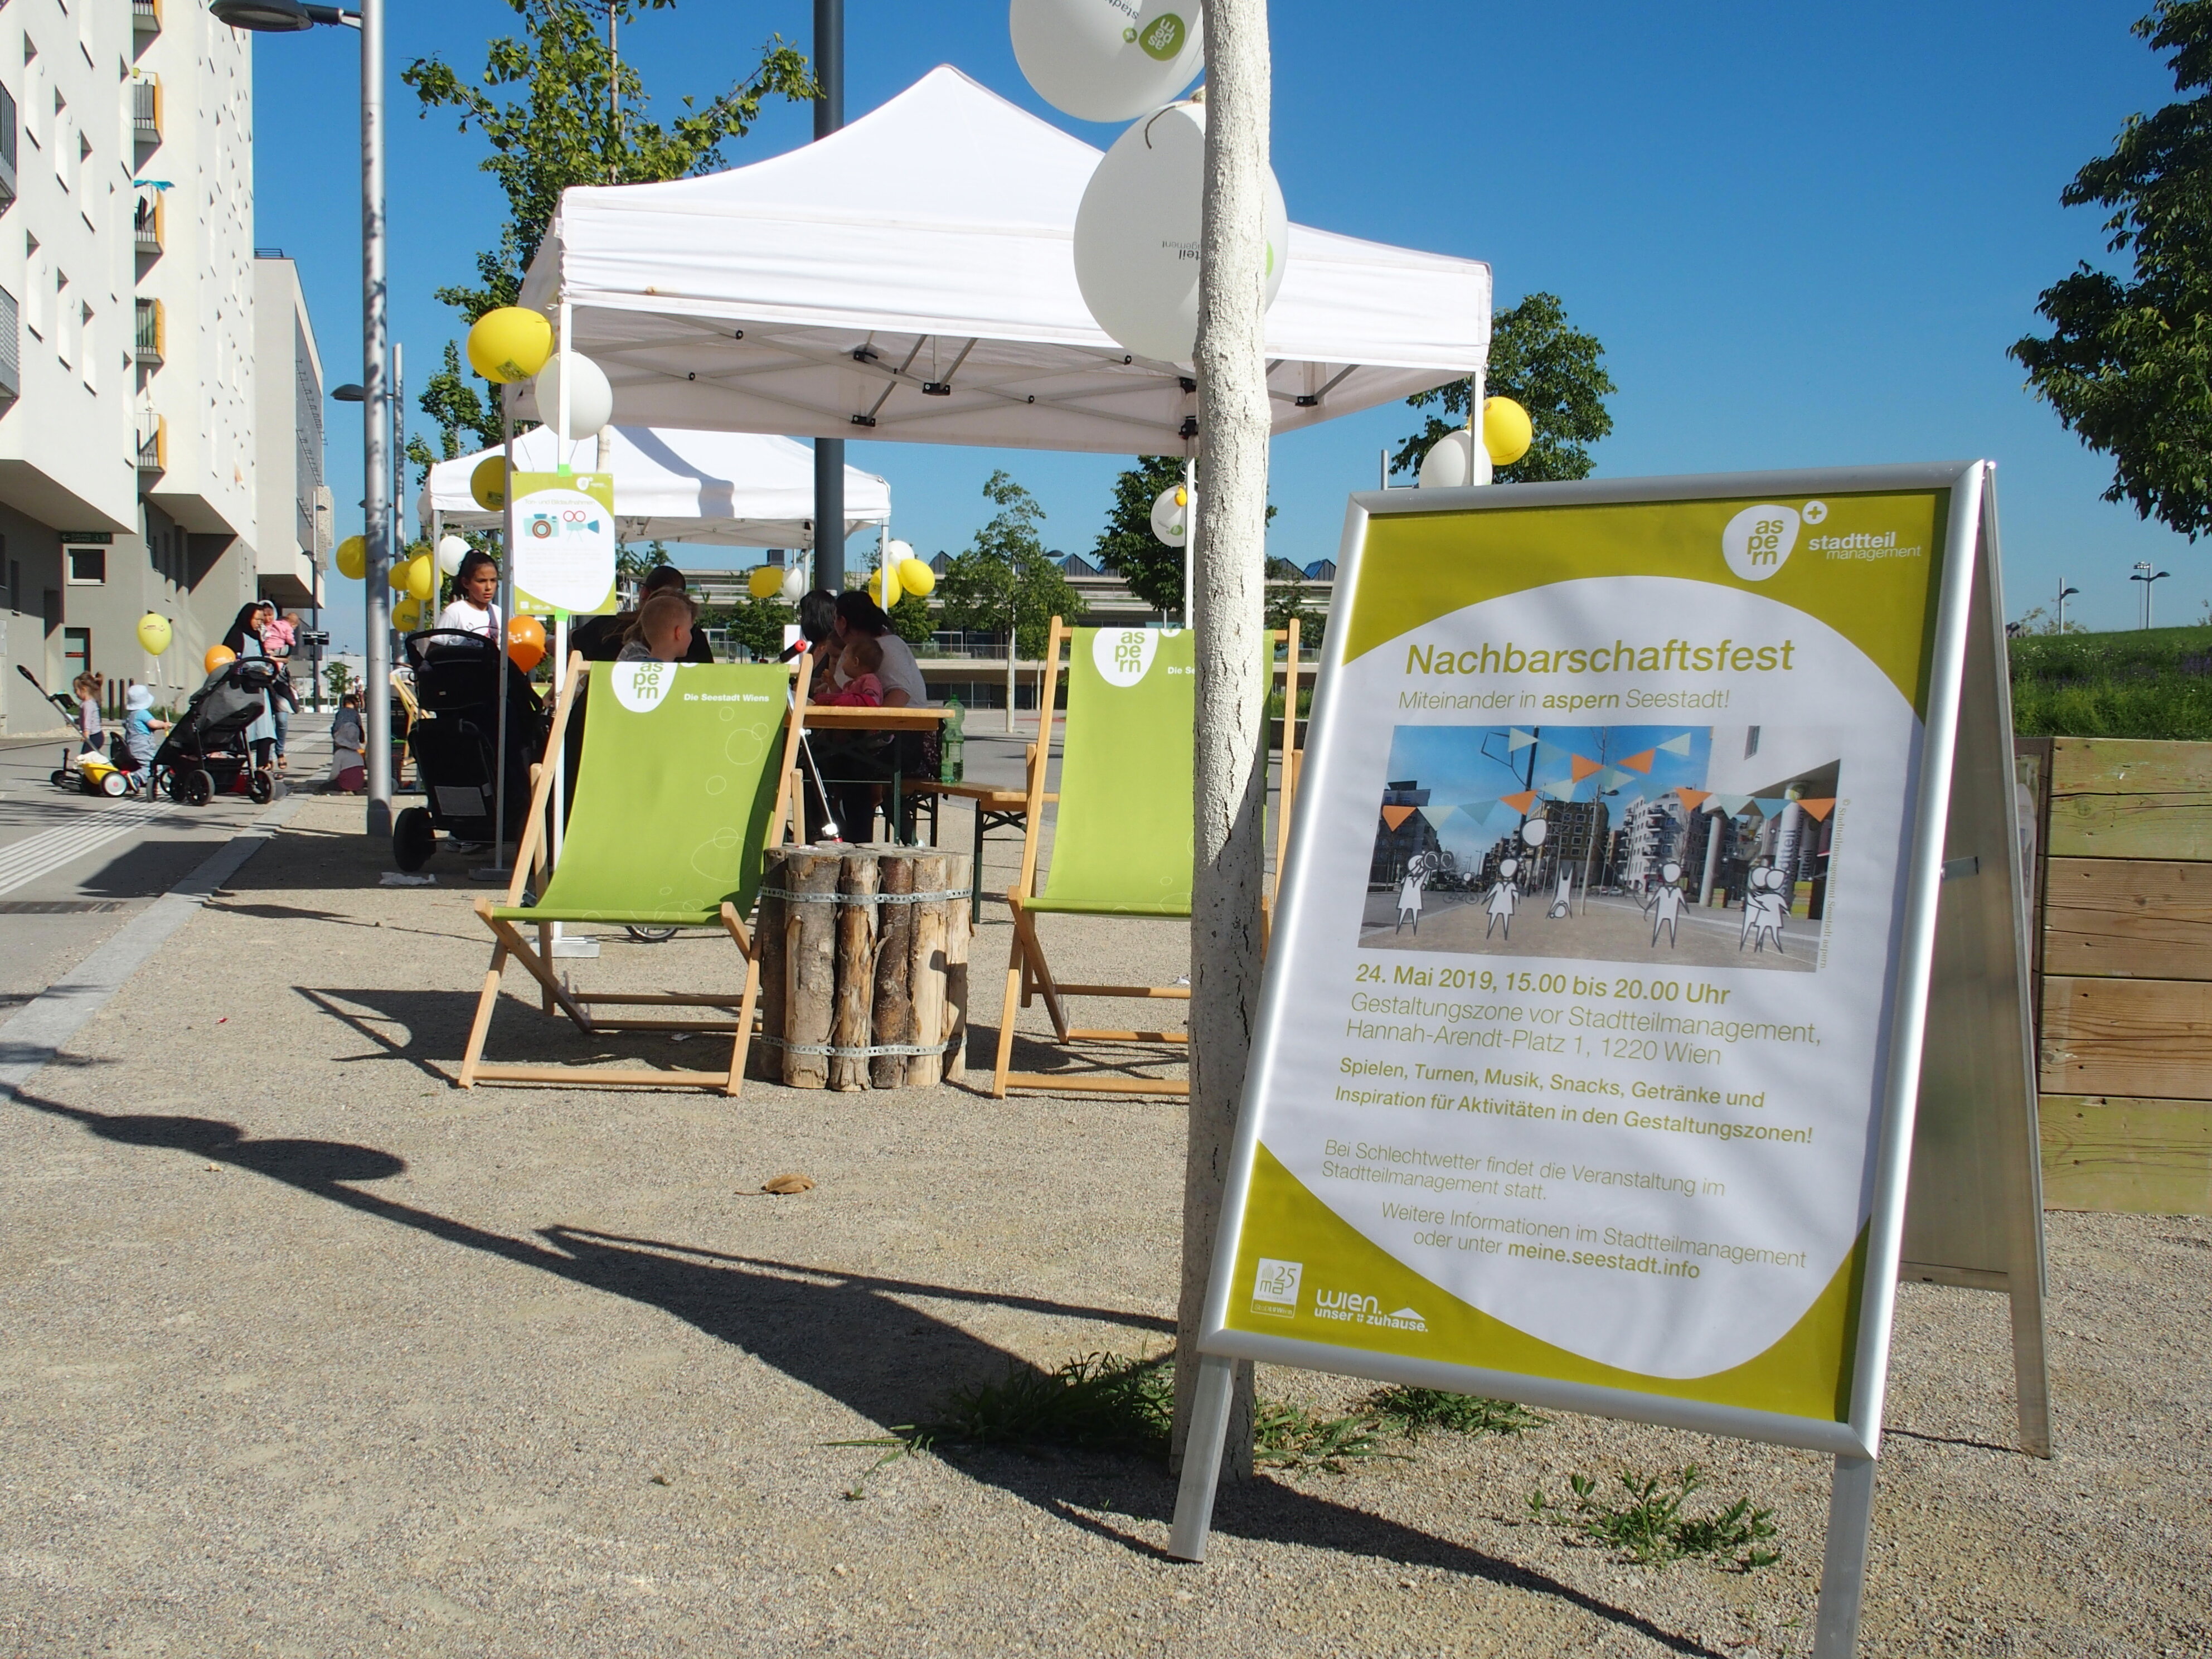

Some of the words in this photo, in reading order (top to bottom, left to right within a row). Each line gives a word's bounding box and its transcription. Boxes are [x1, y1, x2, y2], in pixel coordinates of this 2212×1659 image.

[1808, 531, 1896, 551] stadtteil
[1826, 546, 1922, 561] management
[1405, 638, 1795, 675] Nachbarschaftsfest
[1399, 690, 1515, 709] Miteinander
[1519, 690, 1536, 707] in
[1541, 694, 1619, 713] aspern
[1626, 688, 1729, 708] Seestadt!
[1828, 807, 1846, 899] Stadtteilmanagement
[1823, 901, 1835, 937] Seestadt
[1355, 963, 1386, 983] 24.
[1393, 965, 1433, 986] Mai
[1438, 968, 1497, 993] 2019,
[1506, 972, 1566, 994] 15.00
[1571, 975, 1607, 997] bis
[1613, 978, 1679, 1001] 20.00
[1686, 982, 1730, 1005] Uhr
[1351, 991, 1523, 1023] Gestaltungszone
[1529, 1007, 1564, 1023] vor
[1568, 1005, 1820, 1046] Stadtteilmanagement,
[1346, 1018, 1565, 1052] Hannah-Arendt-Platz
[1574, 1035, 1590, 1057] 1,
[1602, 1037, 1657, 1060] 1220
[1664, 1041, 1721, 1065] Wien
[1339, 1056, 1408, 1080] Spielen,
[1414, 1063, 1478, 1086] Turnen,
[1484, 1068, 1543, 1091] Musik,
[1549, 1073, 1624, 1098] Snacks,
[1631, 1080, 1721, 1104] Getränke
[1726, 1091, 1765, 1108] und
[1335, 1085, 1426, 1108] Inspiration
[1430, 1093, 1455, 1110] für
[1456, 1095, 1556, 1119] Aktivitäten
[1560, 1104, 1577, 1121] in
[1582, 1107, 1618, 1125] den
[1623, 1110, 1813, 1143] Gestaltungszonen!
[1322, 1160, 1498, 1195] Stadtteilmanagement
[1503, 1182, 1545, 1200] statt.
[1325, 1139, 1350, 1157] Bei
[1355, 1142, 1481, 1170] Schlechtwetter
[1487, 1156, 1534, 1176] findet
[1539, 1162, 1565, 1179] die
[1572, 1164, 1696, 1197] Veranstaltung
[1702, 1182, 1724, 1195] im
[1382, 1201, 1444, 1224] Weitere
[1450, 1209, 1569, 1239] Informationen
[1575, 1224, 1597, 1242] im
[1603, 1227, 1806, 1268] Stadtteilmanagement
[1413, 1230, 1453, 1247] oder
[1458, 1236, 1502, 1253] unter
[1507, 1242, 1700, 1278] meine.seestadt.info
[1314, 1307, 1353, 1321] unser
[1366, 1315, 1428, 1332] zuhause.
